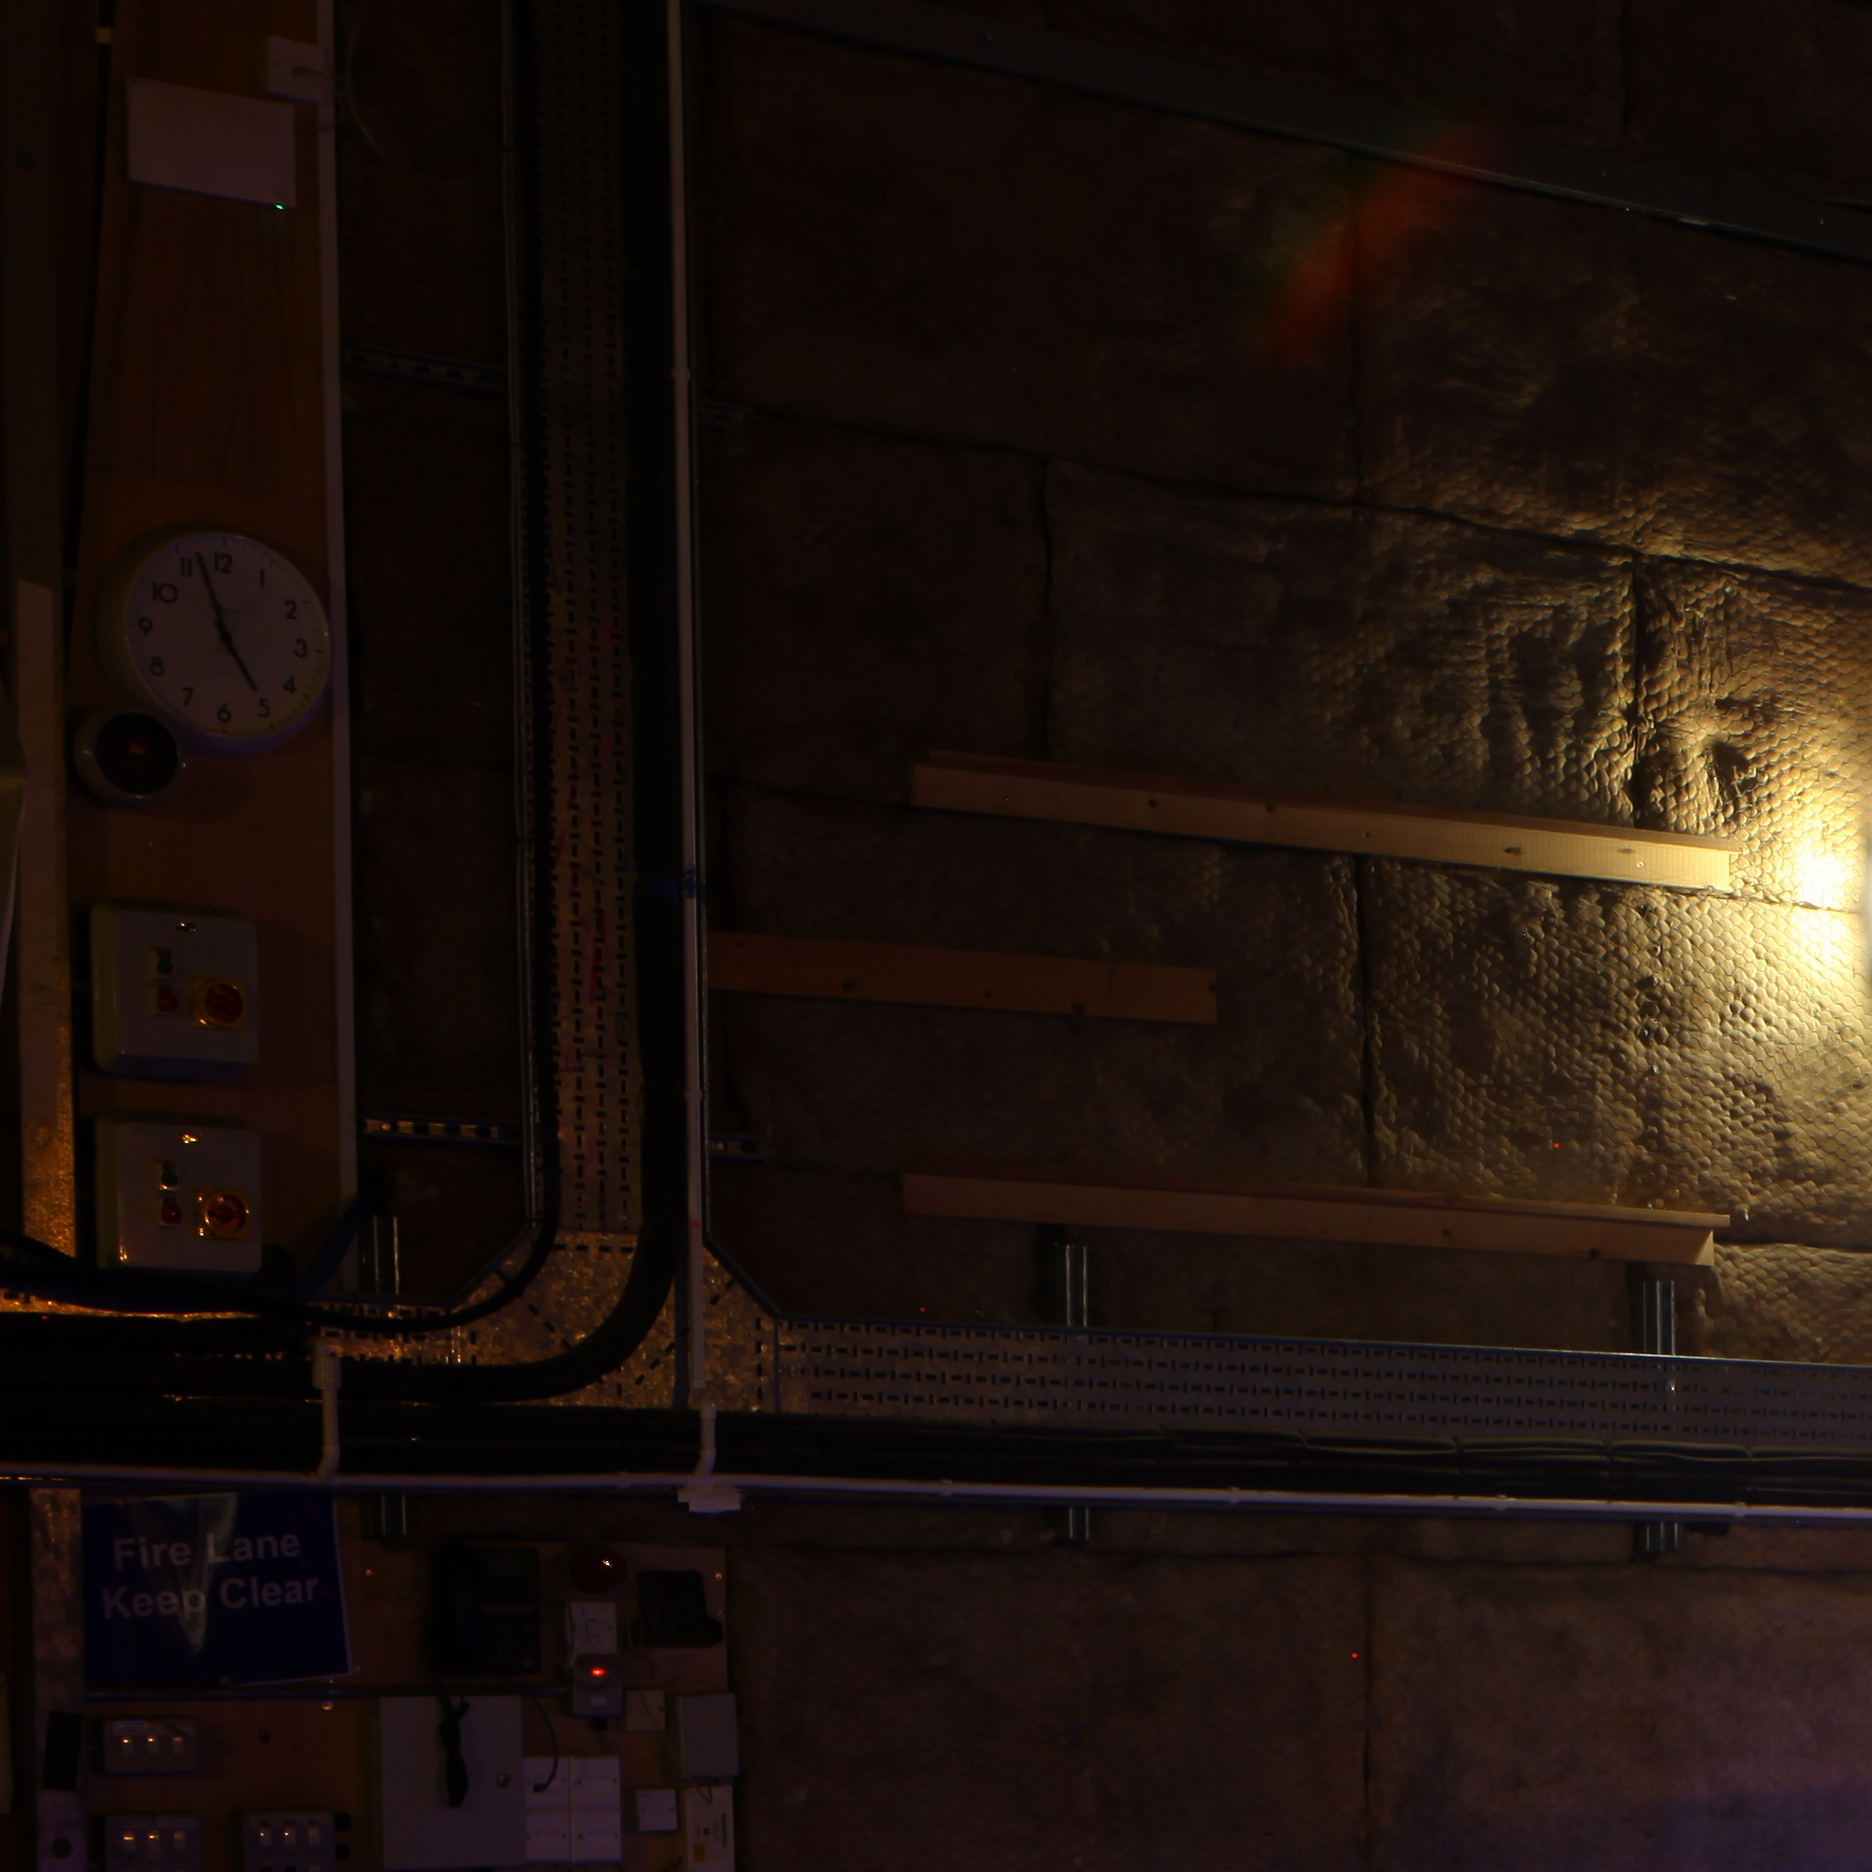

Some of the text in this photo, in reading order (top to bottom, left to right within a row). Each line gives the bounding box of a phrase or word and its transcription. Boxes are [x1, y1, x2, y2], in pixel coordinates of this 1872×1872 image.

[180, 557, 193, 578] 11
[214, 552, 233, 574] 12
[152, 581, 178, 603] 10
[284, 599, 297, 620] 2
[137, 617, 153, 637] 9
[293, 638, 308, 659] 3
[151, 656, 164, 676] 8
[282, 675, 297, 694] 4
[181, 687, 194, 707] 7
[216, 703, 232, 723] 6
[257, 698, 271, 718] 5
[113, 1532, 301, 1571] Fire Lane
[102, 1576, 319, 1620] Keep Clear
